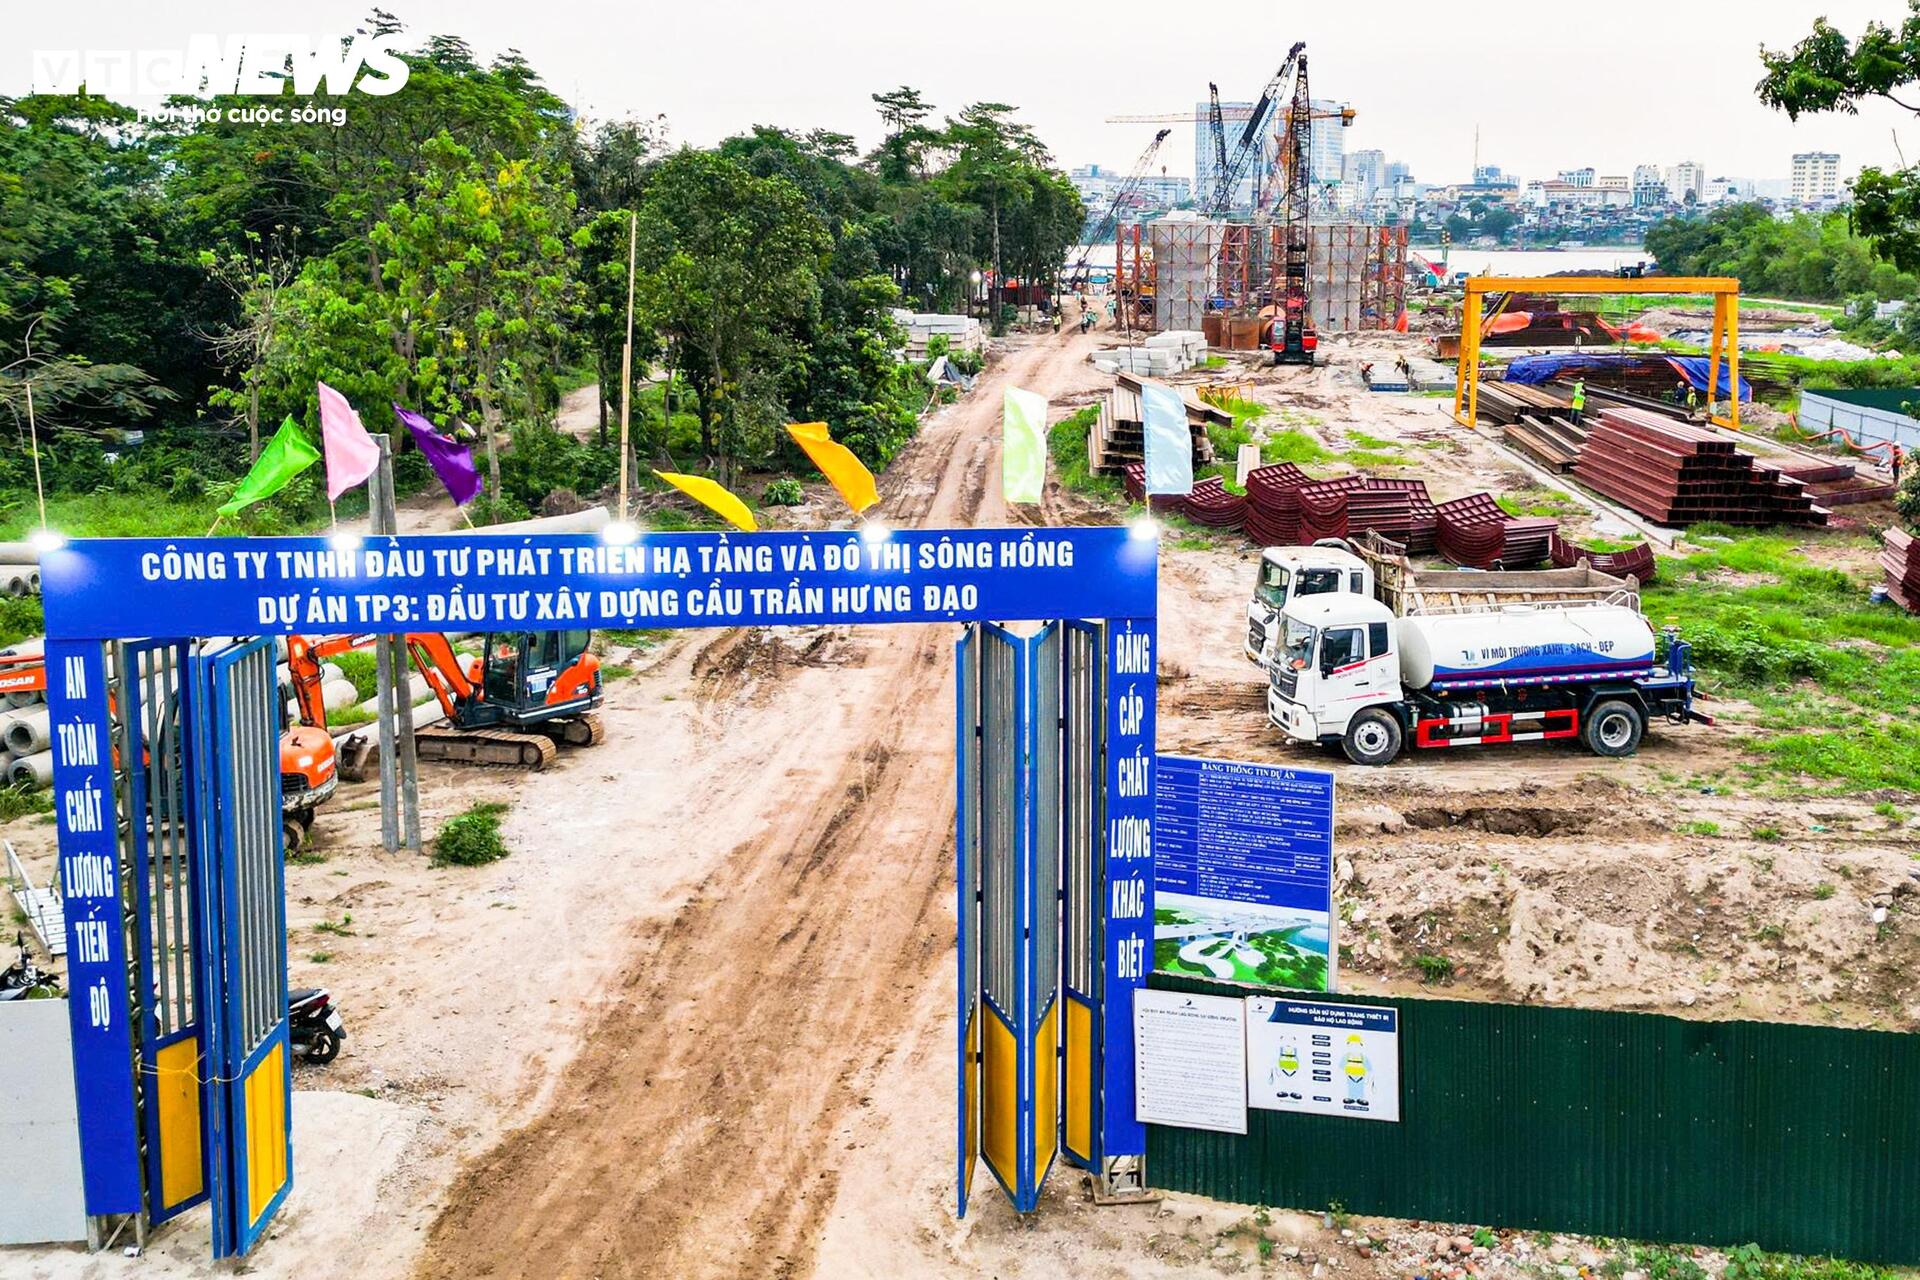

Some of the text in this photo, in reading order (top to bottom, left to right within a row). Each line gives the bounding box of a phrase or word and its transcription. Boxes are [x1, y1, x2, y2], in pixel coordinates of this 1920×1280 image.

[142, 545, 225, 580] CÔNG
[234, 552, 267, 578] TY
[277, 551, 356, 578] TNHH
[365, 537, 424, 577] ĐẦU
[433, 547, 470, 576] TƯ
[479, 539, 551, 575] PHÁT
[654, 547, 691, 578] HẠ
[699, 534, 772, 572] TẦNG
[781, 536, 816, 570] VÀ
[824, 538, 860, 570] ĐÔ
[867, 543, 910, 573] THỊ
[919, 537, 992, 568] SÔNG
[1001, 532, 1072, 567] HỒNG
[259, 578, 977, 630] DỰ ÁN TP3: ĐẦU TƯ XÂY DỰNG CẦU TRẦN HƯNG ĐẠO
[1541, 643, 1564, 656] XANH
[66, 657, 86, 698] AN
[1120, 684, 1143, 735] CẤP
[59, 716, 97, 766] TOÀN
[1119, 744, 1148, 797] CHẤT
[1255, 769, 1270, 777] TIN
[66, 776, 102, 832] CHẤT
[1111, 816, 1150, 861] LƯỢNG
[66, 852, 113, 904] LƯỢNG
[1112, 870, 1144, 918] KHÁC
[75, 906, 108, 962] TIẾN
[1119, 932, 1144, 981] BIỆT
[90, 977, 109, 1030] ĐỘ
